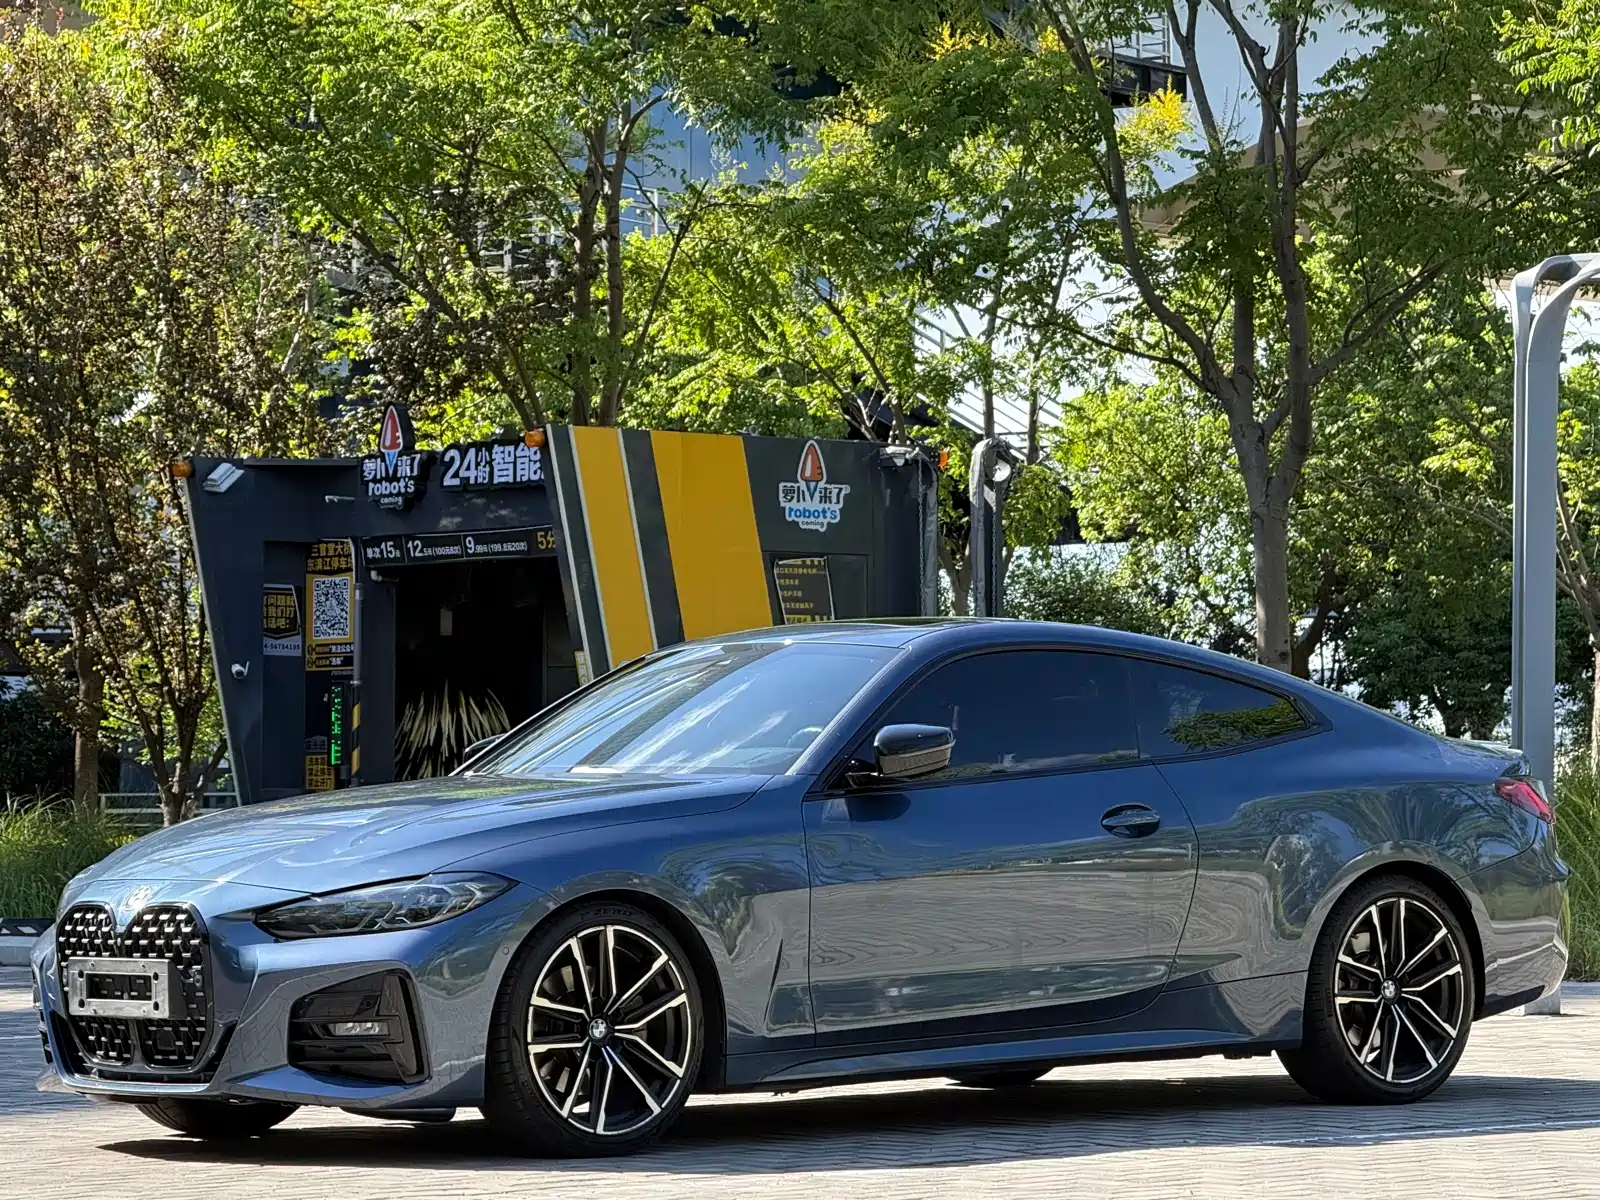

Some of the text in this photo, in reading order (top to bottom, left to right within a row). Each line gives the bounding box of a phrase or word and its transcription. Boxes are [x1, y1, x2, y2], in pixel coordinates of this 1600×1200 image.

[443, 443, 544, 486] 24小时智能
[368, 478, 415, 496] robot's
[380, 496, 403, 505] coming
[788, 506, 838, 520] robot's
[801, 520, 825, 529] coming
